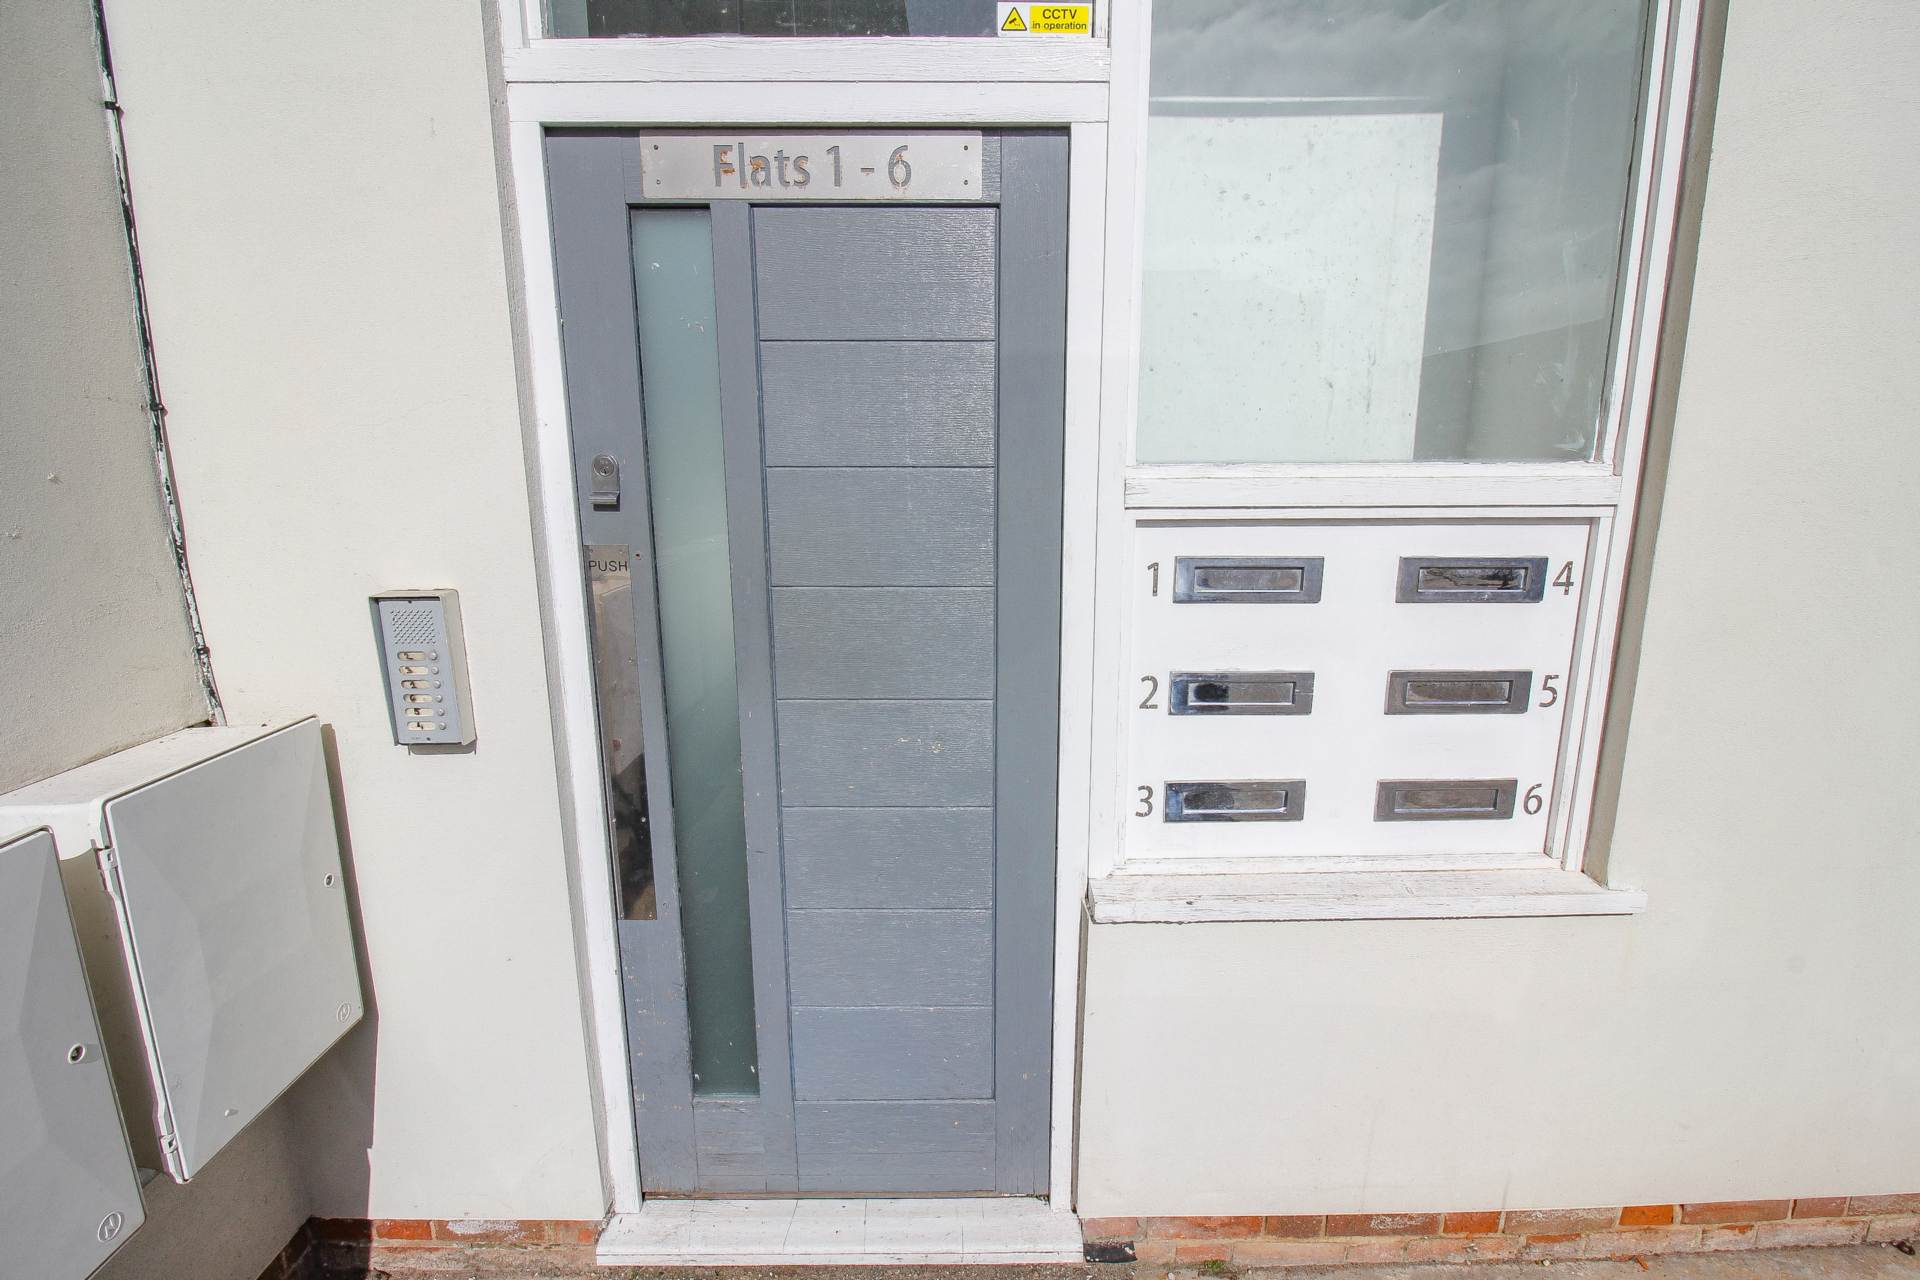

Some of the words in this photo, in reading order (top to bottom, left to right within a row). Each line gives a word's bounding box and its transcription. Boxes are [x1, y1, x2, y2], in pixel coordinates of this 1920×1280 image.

[1032, 21, 1040, 29] in
[1043, 21, 1087, 31] operation
[1042, 8, 1077, 20] CCTV
[713, 142, 811, 189] Flats
[826, 145, 842, 188] 1
[887, 144, 912, 188] 6
[588, 560, 628, 572] PUSH
[1146, 561, 1160, 598] 1
[1552, 560, 1575, 597] 4
[1138, 674, 1160, 710] 2
[1538, 673, 1560, 708] 5
[1134, 784, 1154, 818] 3
[1523, 782, 1543, 816] 6
